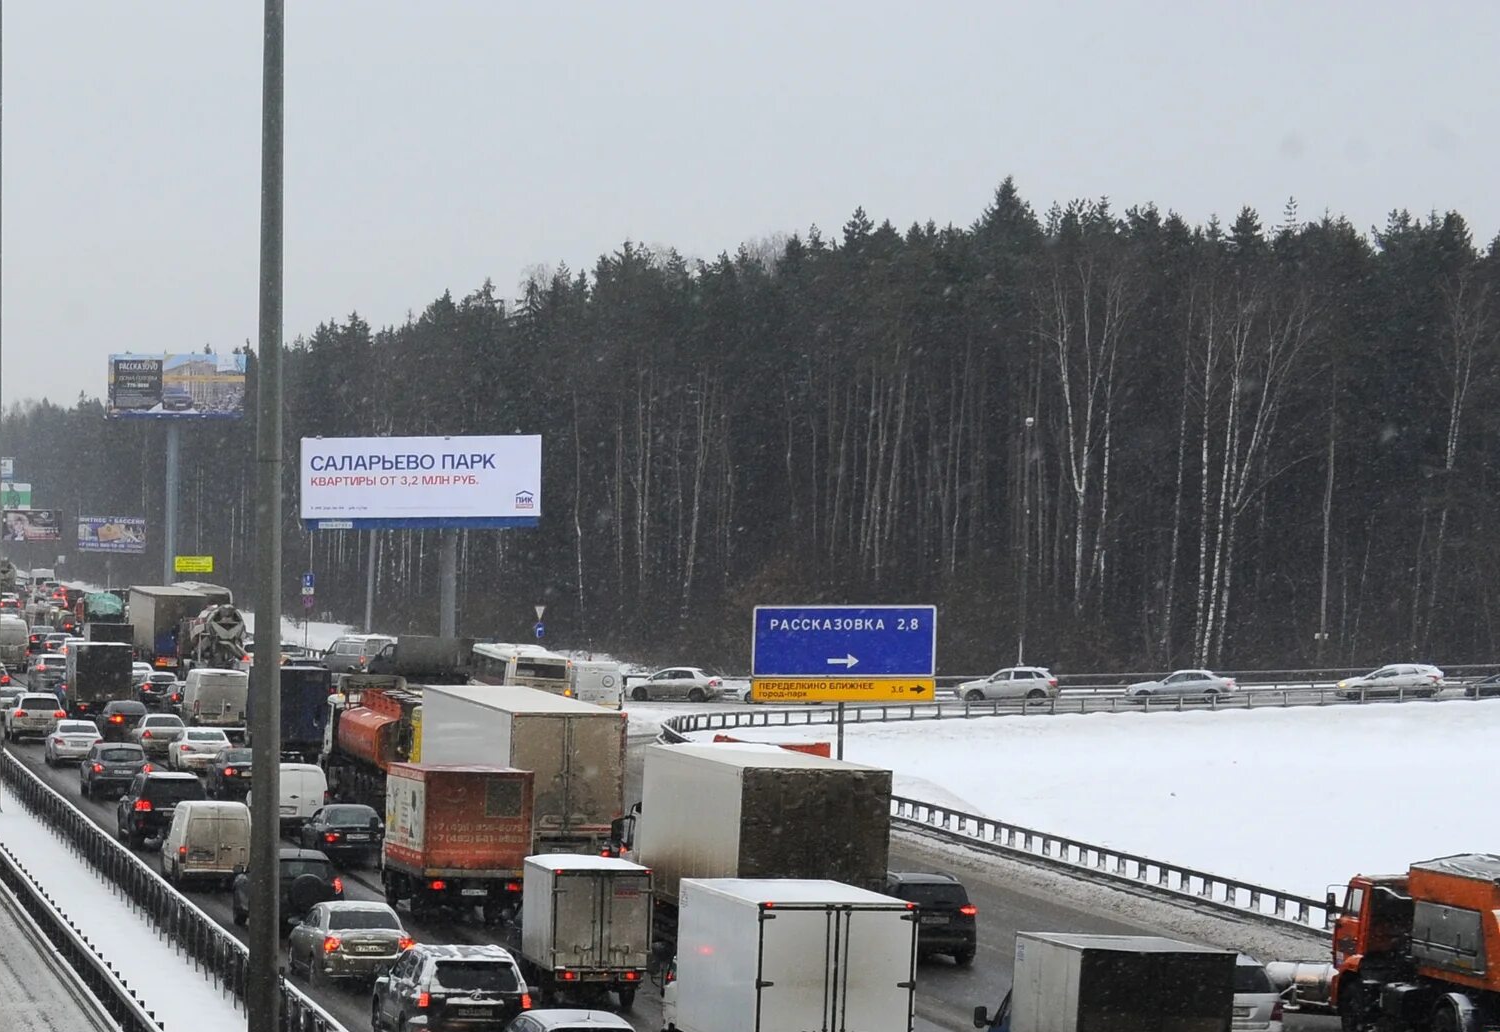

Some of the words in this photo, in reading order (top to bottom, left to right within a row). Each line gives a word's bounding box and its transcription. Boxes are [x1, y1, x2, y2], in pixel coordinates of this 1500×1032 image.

[310, 454, 436, 471] САЛАРЬЕВО
[441, 453, 496, 470] ПАРК
[310, 476, 377, 487] КВАРТИРЫ
[380, 476, 396, 486] ОТ
[400, 475, 419, 487] 3,2
[421, 475, 450, 486] МЛН
[453, 475, 480, 486] РУБ.
[515, 496, 533, 504] ПИК
[770, 618, 885, 631] РАССКАЗОВКА
[896, 618, 919, 631] 2,8
[758, 682, 826, 690] ПЕРЕДЕЛКИНО
[829, 682, 875, 690] БЛИЖНЕЕ
